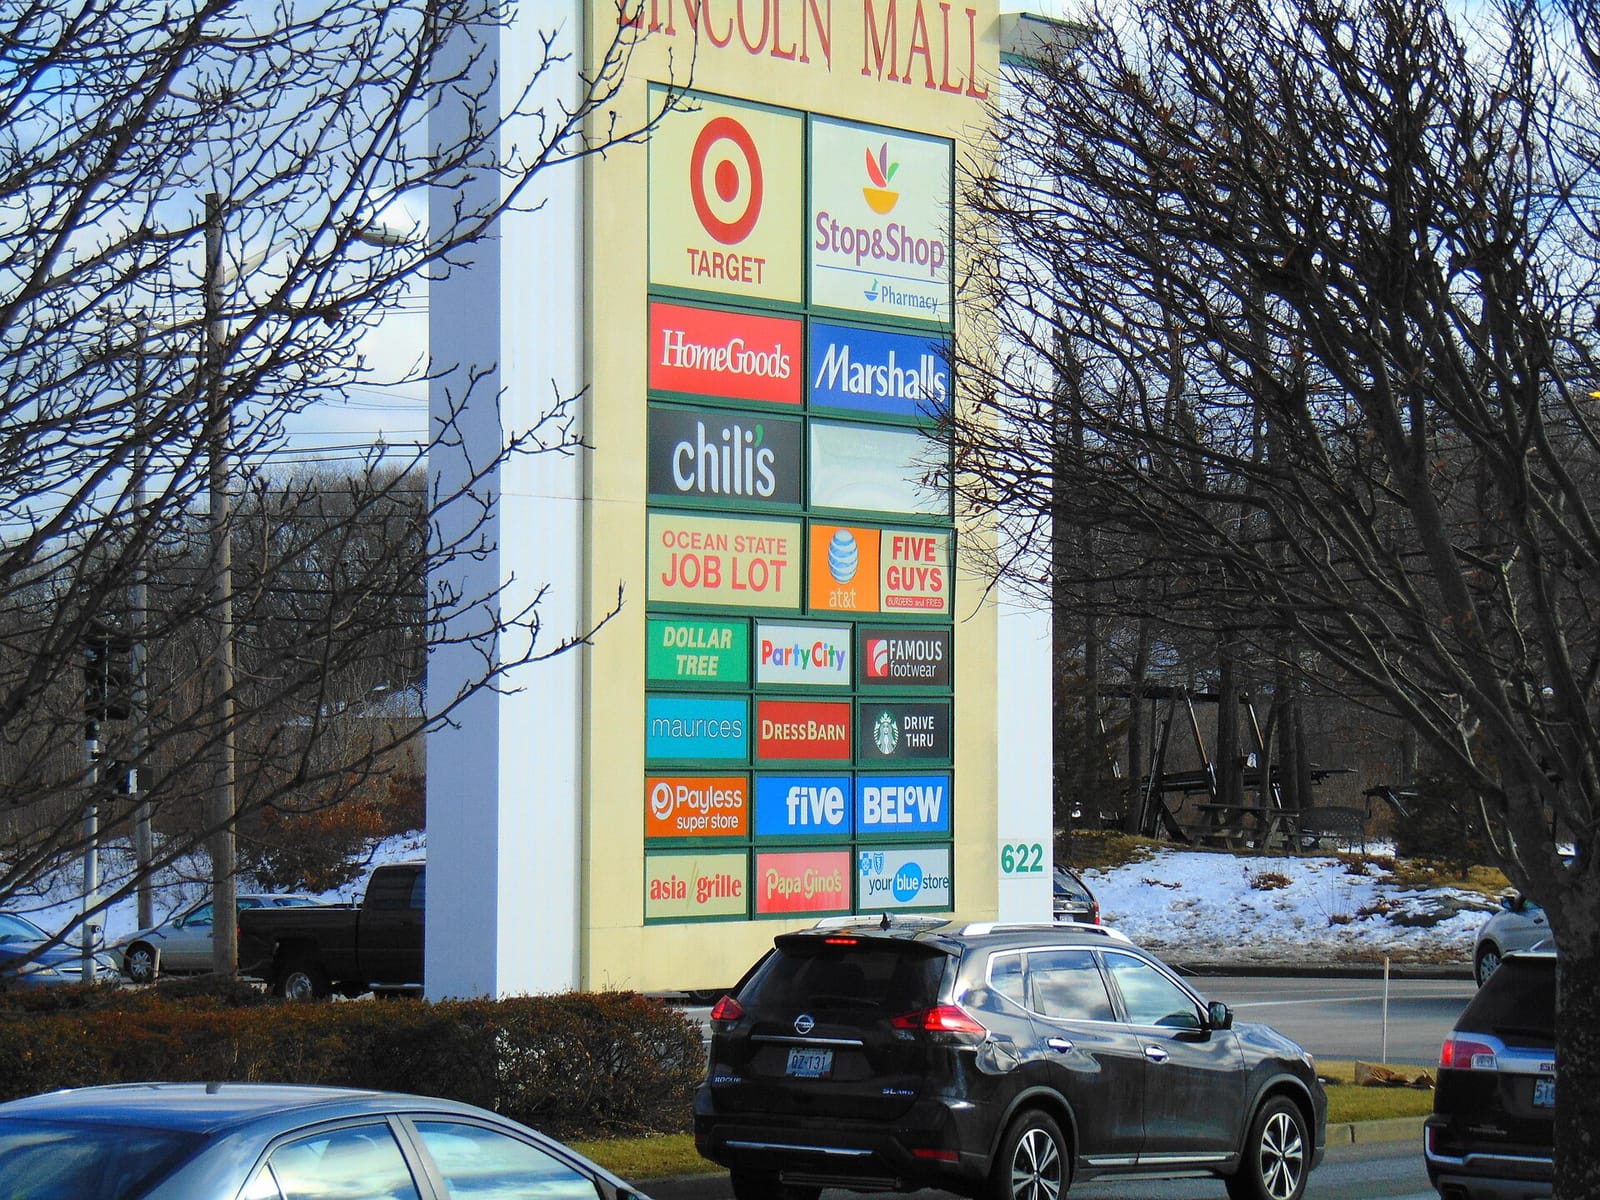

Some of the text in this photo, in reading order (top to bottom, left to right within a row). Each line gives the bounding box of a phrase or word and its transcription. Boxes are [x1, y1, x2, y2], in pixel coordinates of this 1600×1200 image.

[616, 0, 989, 99] COLN MALL
[815, 211, 945, 276] Stop&Shop
[687, 248, 765, 284] TARGET
[881, 284, 938, 312] Pharmacy
[661, 328, 791, 379] HomeGoods
[815, 343, 946, 402] Marshalls
[672, 421, 776, 497] chili's
[662, 530, 787, 556] OCEAN STATE
[892, 536, 936, 562] FIVE
[661, 553, 787, 593] JOB LOT
[886, 565, 943, 592] GUYS
[828, 587, 857, 609] at&t
[663, 626, 733, 649] DOLLAR
[890, 639, 943, 661] FAMOUS
[676, 655, 719, 676] TREE
[890, 661, 937, 678] footwear
[652, 718, 743, 738] maurices
[904, 716, 935, 730] DRIVE
[905, 733, 934, 747] THRU
[676, 785, 743, 815] Payless
[786, 786, 943, 826] five BELOW
[677, 813, 739, 832] super store
[1001, 843, 1043, 873] 622
[650, 873, 742, 904] asia grille
[765, 867, 842, 900] Papa Gino's
[868, 873, 949, 896] your blue store
